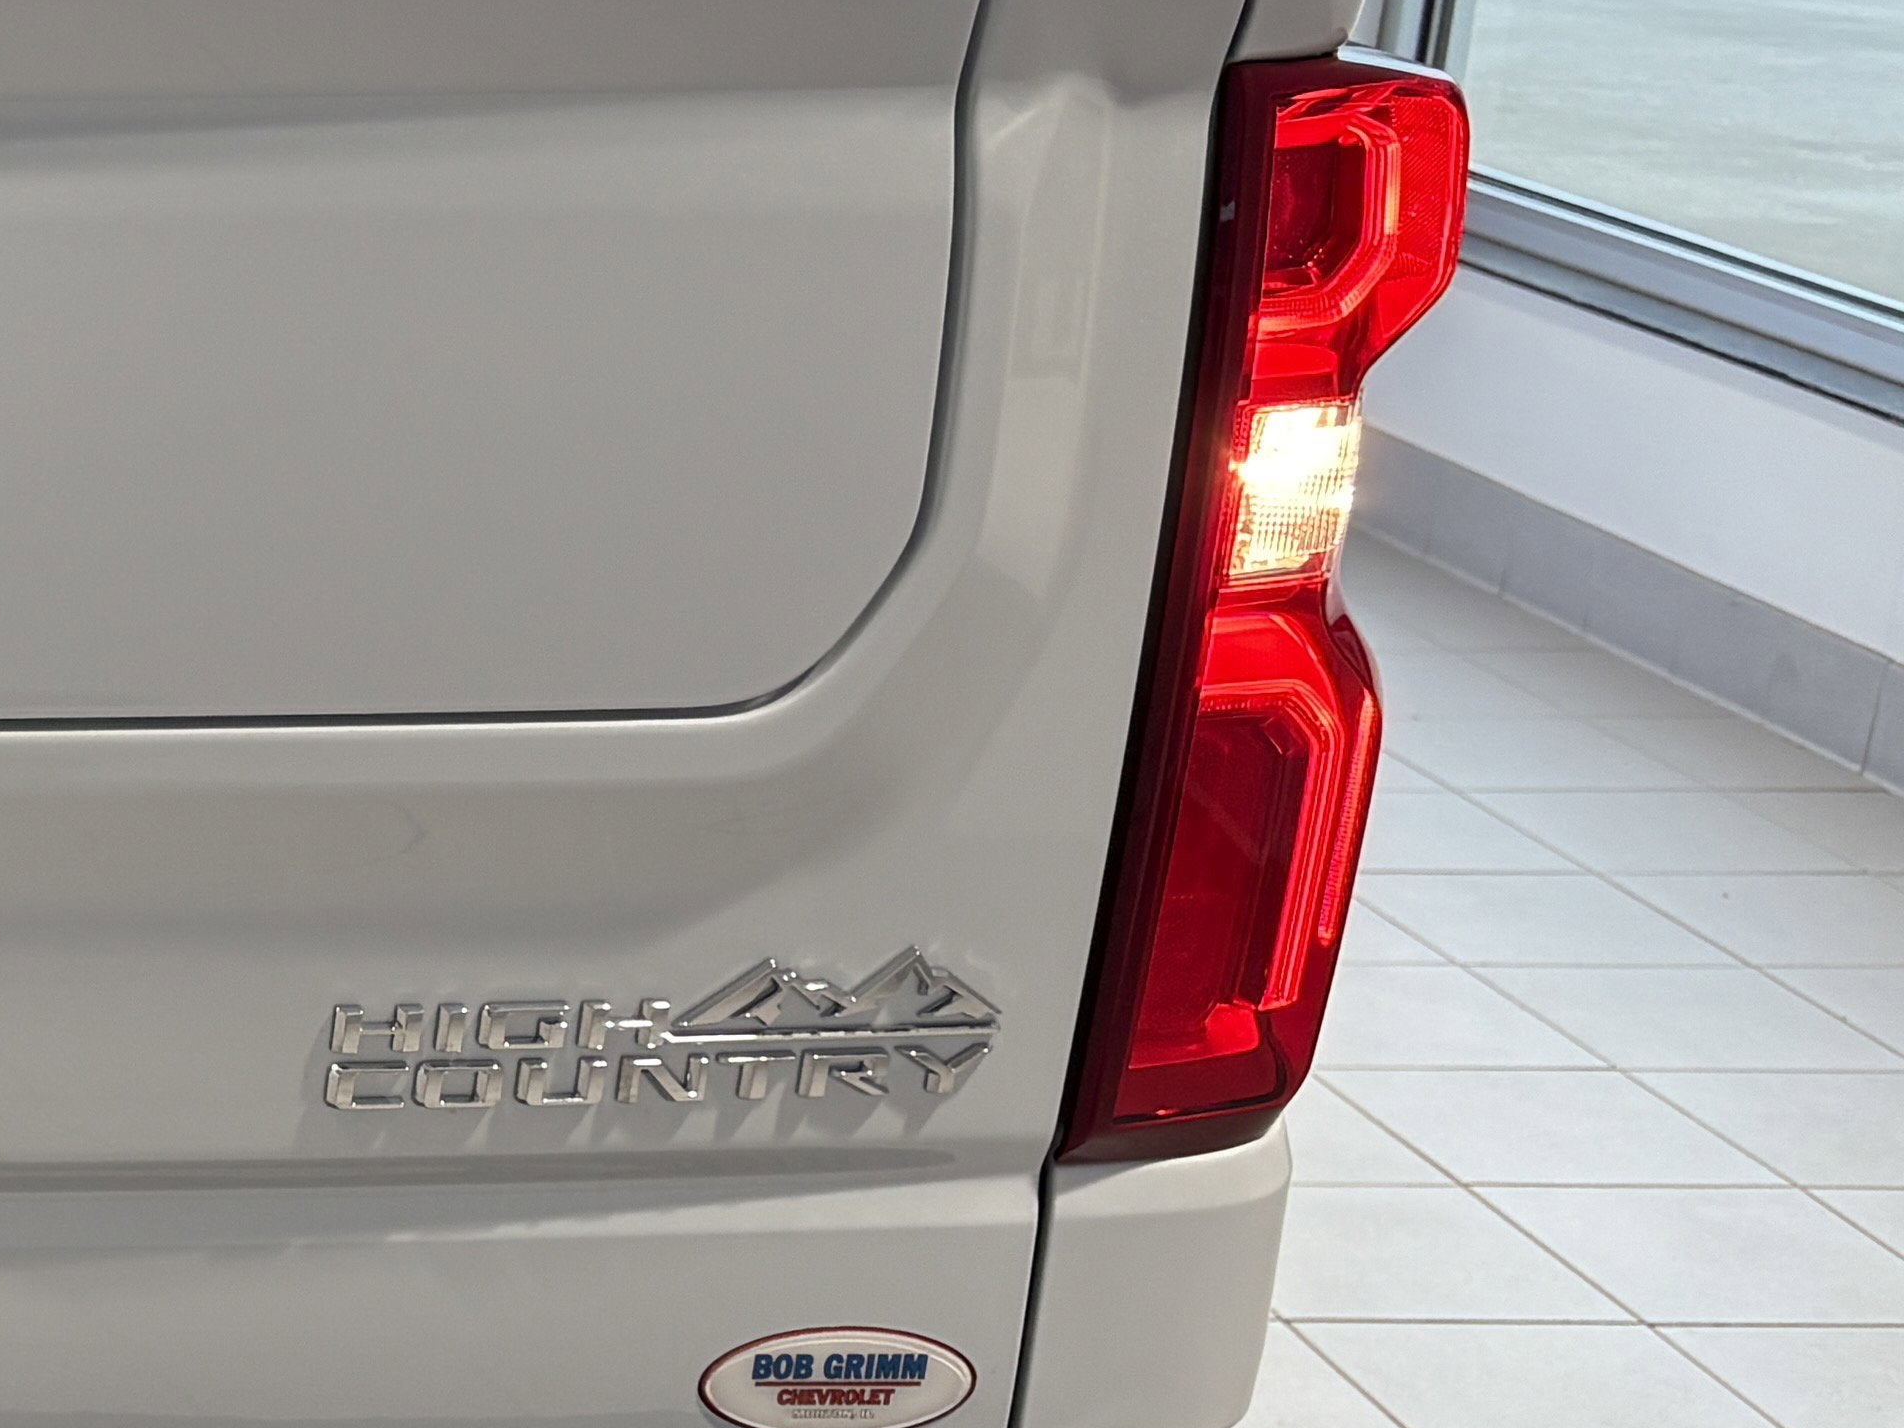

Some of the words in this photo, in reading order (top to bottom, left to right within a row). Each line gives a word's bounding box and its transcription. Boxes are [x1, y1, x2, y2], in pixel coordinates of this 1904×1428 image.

[330, 998, 672, 1055] HIGH
[323, 1042, 995, 1111] COUNTRY
[752, 1354, 814, 1380] BOB
[823, 1354, 929, 1380] GRIMM
[776, 1389, 896, 1406] CHEVROLET
